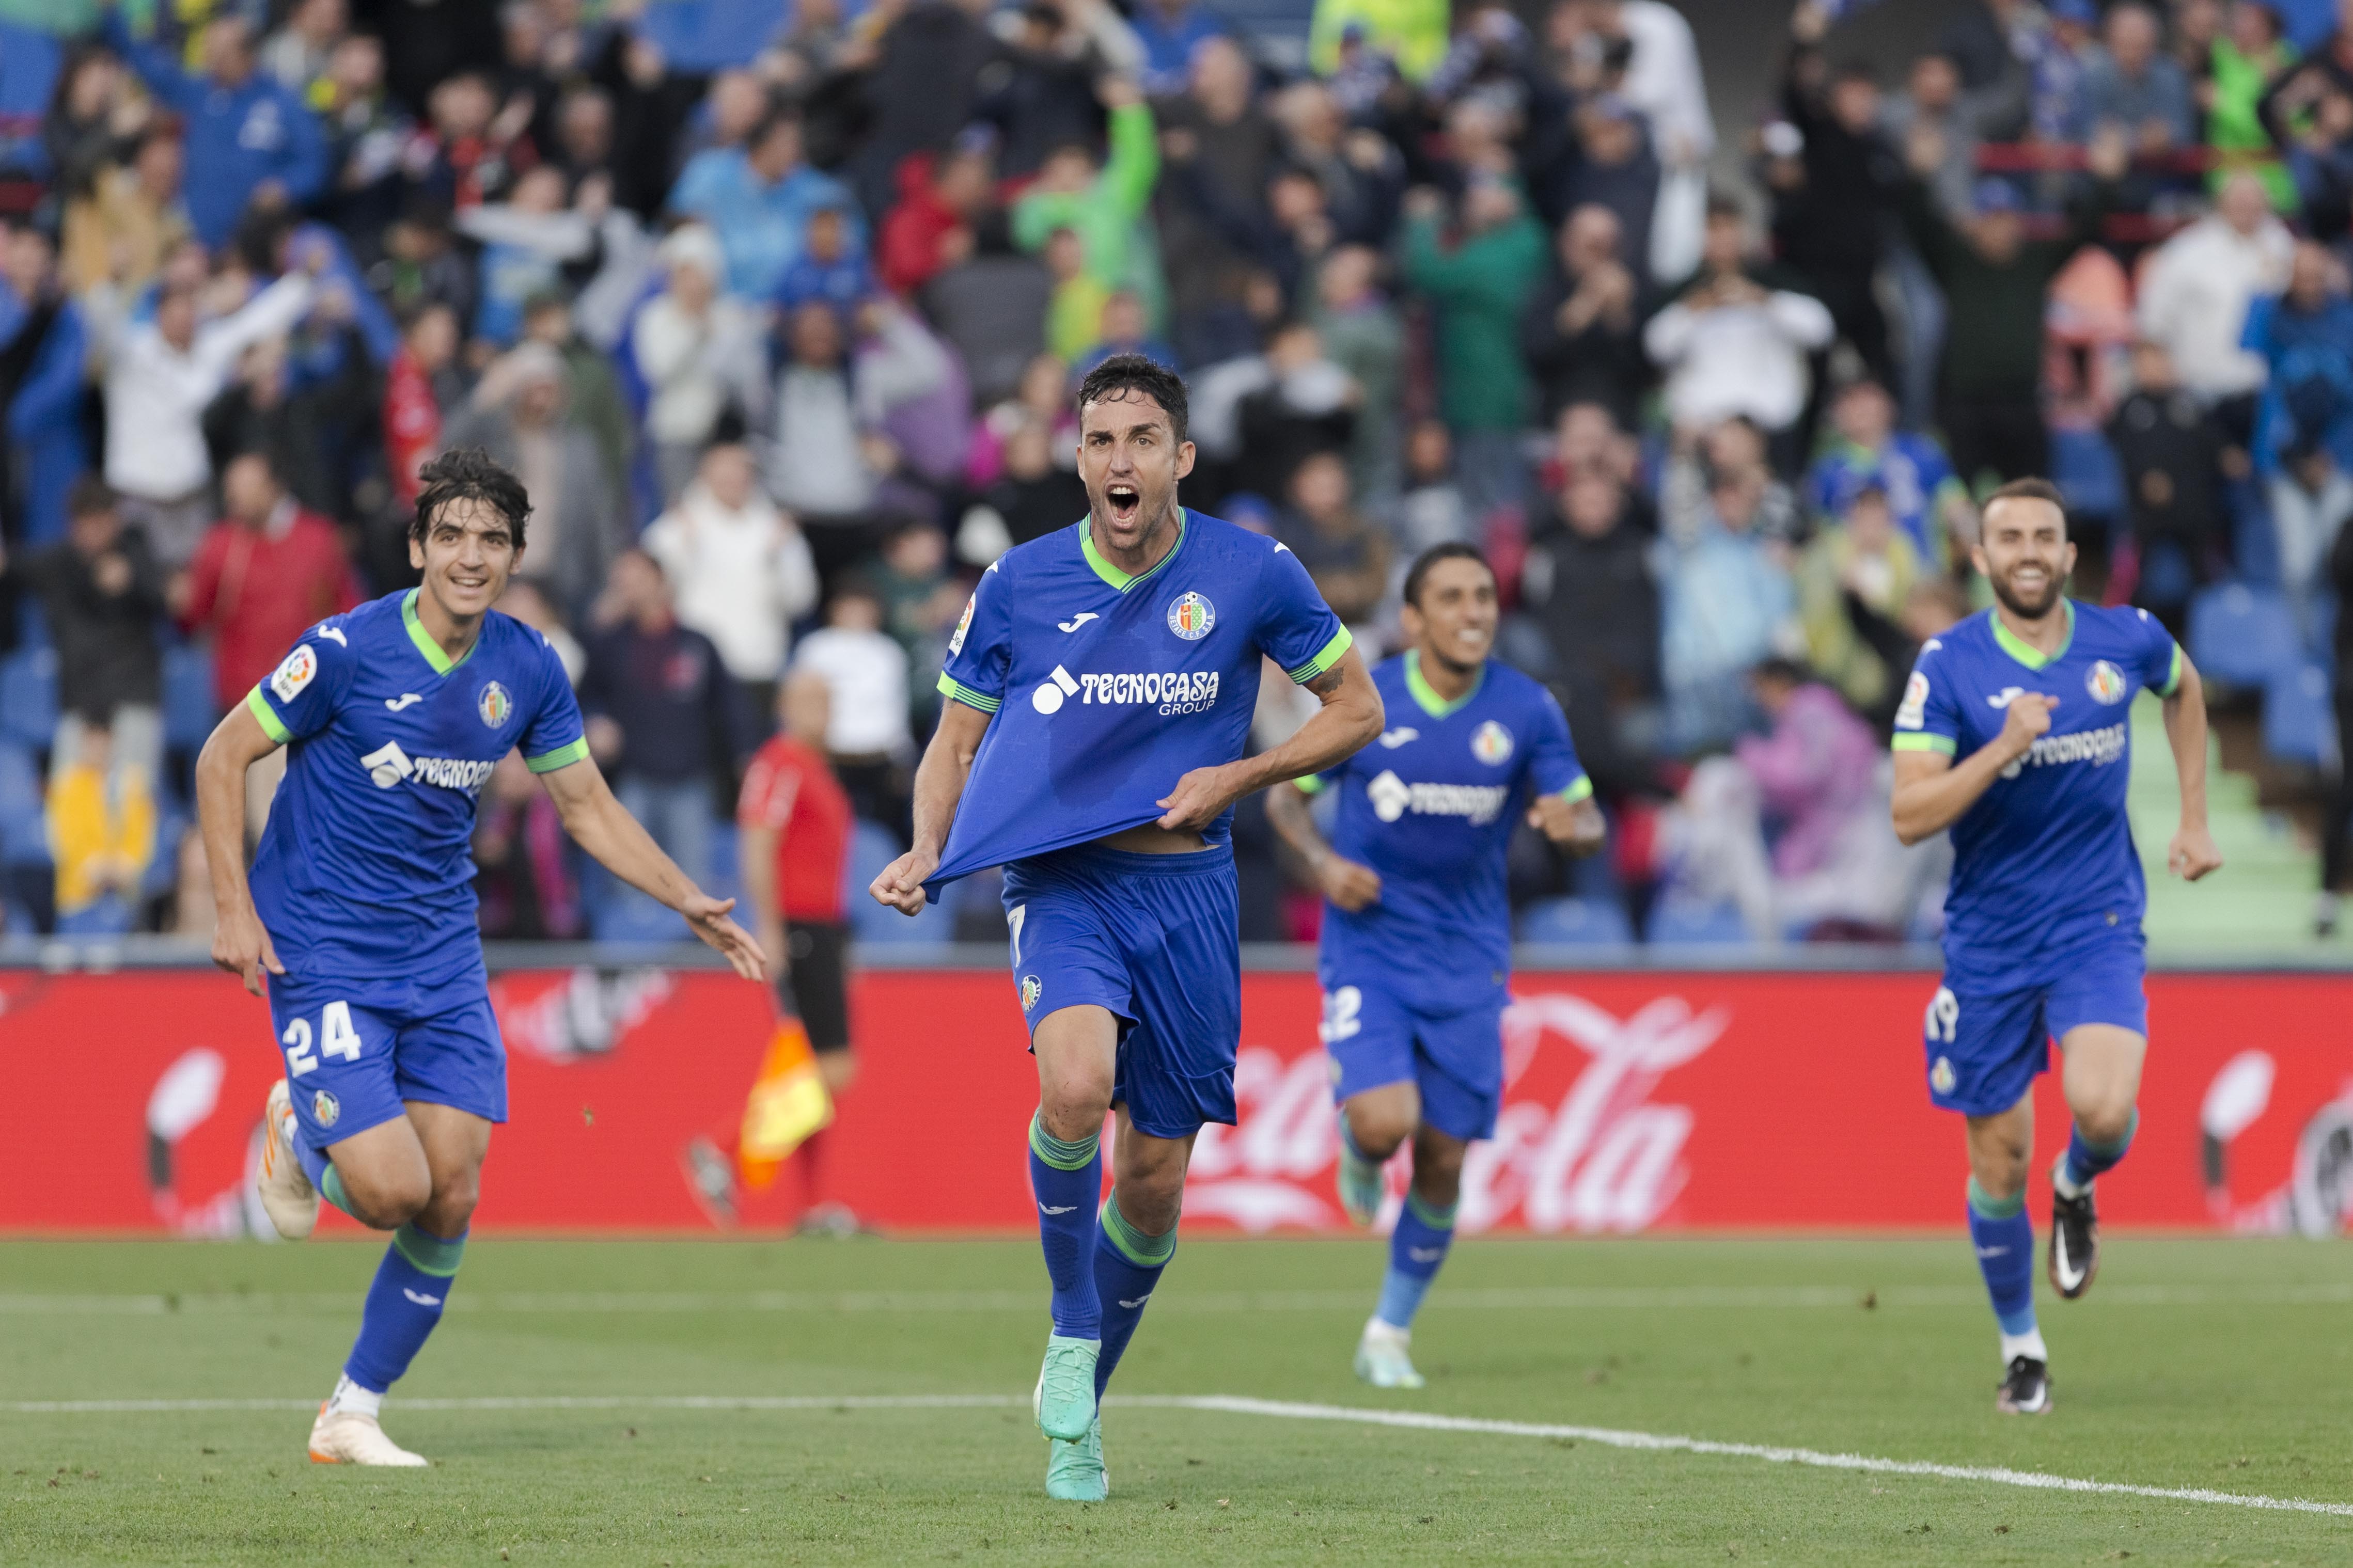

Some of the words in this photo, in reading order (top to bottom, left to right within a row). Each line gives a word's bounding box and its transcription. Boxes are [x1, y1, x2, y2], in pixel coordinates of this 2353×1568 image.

[1170, 615, 1186, 637] GETAFE
[1158, 700, 1215, 716] GROUP
[1007, 904, 1026, 968] 7
[283, 1000, 361, 1078] 24
[1924, 984, 1959, 1043] 19
